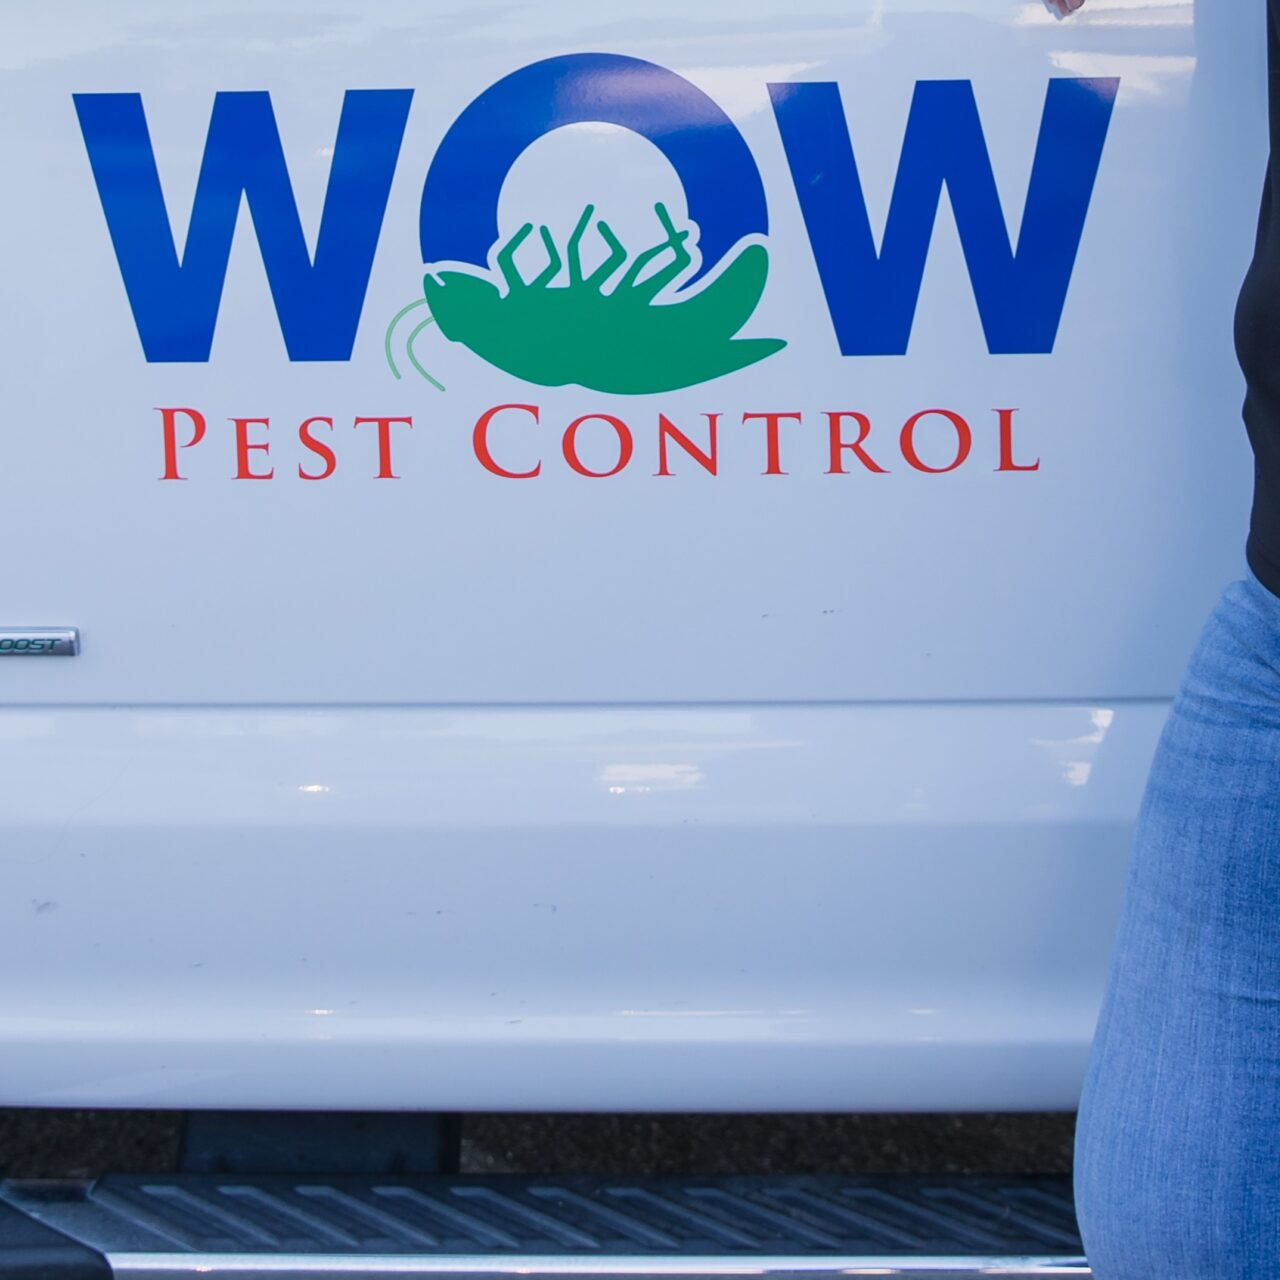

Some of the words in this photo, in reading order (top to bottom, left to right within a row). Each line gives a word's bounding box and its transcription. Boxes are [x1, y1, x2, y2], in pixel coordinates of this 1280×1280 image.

[72, 53, 1121, 363] WOW
[154, 406, 413, 482] PEST
[472, 403, 1041, 480] CONTROL
